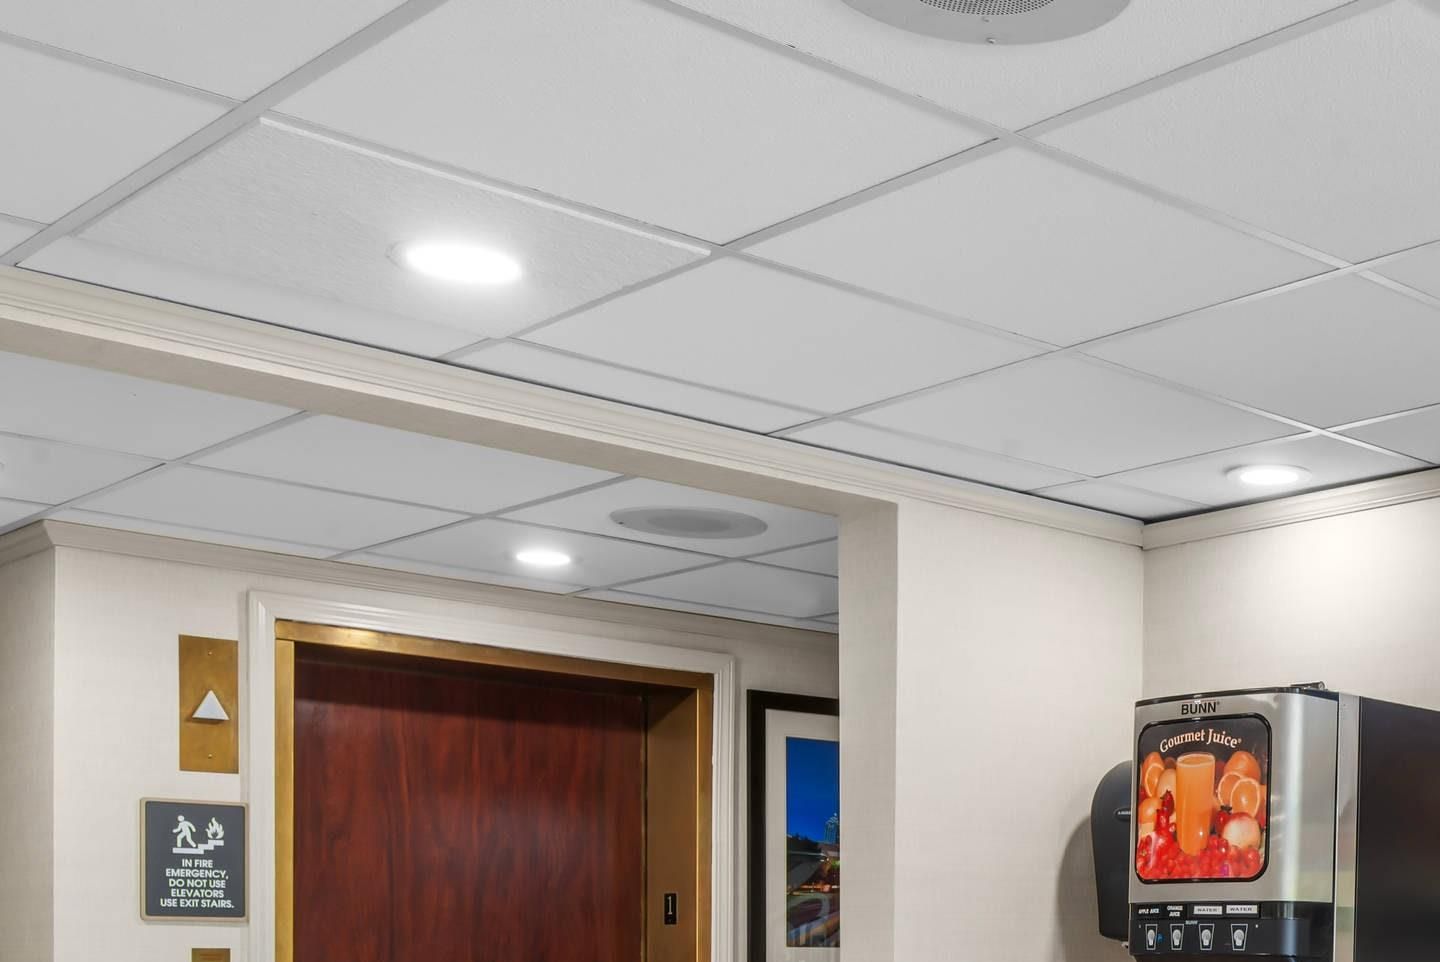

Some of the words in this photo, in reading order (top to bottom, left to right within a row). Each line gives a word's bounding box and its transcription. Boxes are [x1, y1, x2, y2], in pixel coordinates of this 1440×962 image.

[1181, 701, 1216, 715] BUNN
[1160, 729, 1205, 753] Gourmet
[1206, 728, 1238, 748] Juice
[181, 859, 192, 868] IN
[194, 859, 213, 868] FIRE
[165, 868, 229, 879] EMERGENCY,
[168, 878, 185, 888] DO
[186, 879, 207, 888] NOT
[209, 879, 226, 888] USE
[171, 888, 224, 898] ELEVATORS
[160, 898, 178, 907] USE
[180, 898, 199, 908] EXIT
[201, 899, 235, 908] STAIRS.
[667, 895, 673, 915] 1
